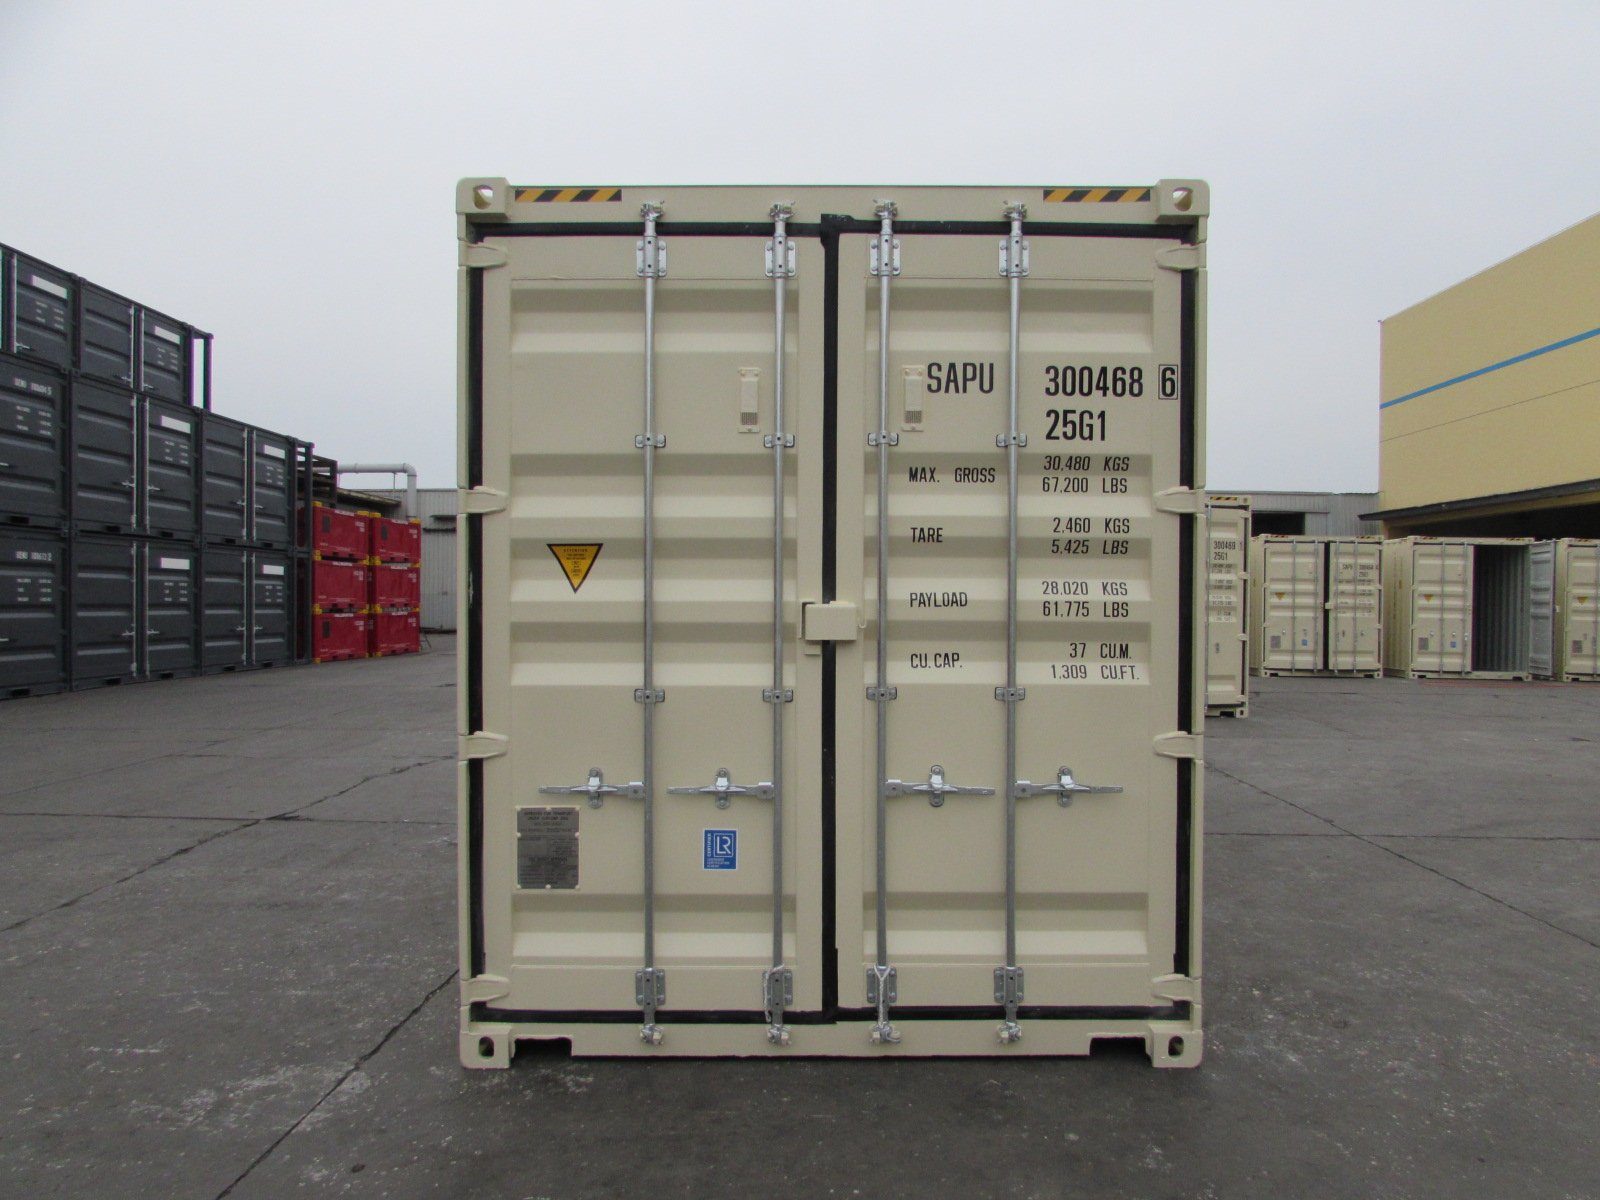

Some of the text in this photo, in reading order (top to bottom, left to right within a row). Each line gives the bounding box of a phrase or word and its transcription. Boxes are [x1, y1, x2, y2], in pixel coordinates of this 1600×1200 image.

[927, 362, 1176, 398] SAPU 300468 6
[1046, 409, 1106, 441] 25G1
[1104, 456, 1130, 472] KGS
[909, 467, 996, 483] MAX. GROSS
[1043, 477, 1128, 493] 67,200 LBS
[1104, 517, 1130, 533] KGS
[910, 527, 943, 543] TARE
[1103, 539, 1129, 554] LBS
[1102, 581, 1128, 596] KGS
[909, 592, 968, 607] PAYLOAD
[1103, 601, 1129, 617] LBS
[1069, 642, 1132, 659] 37 CU.M.
[1100, 665, 1140, 680] CU.FT.
